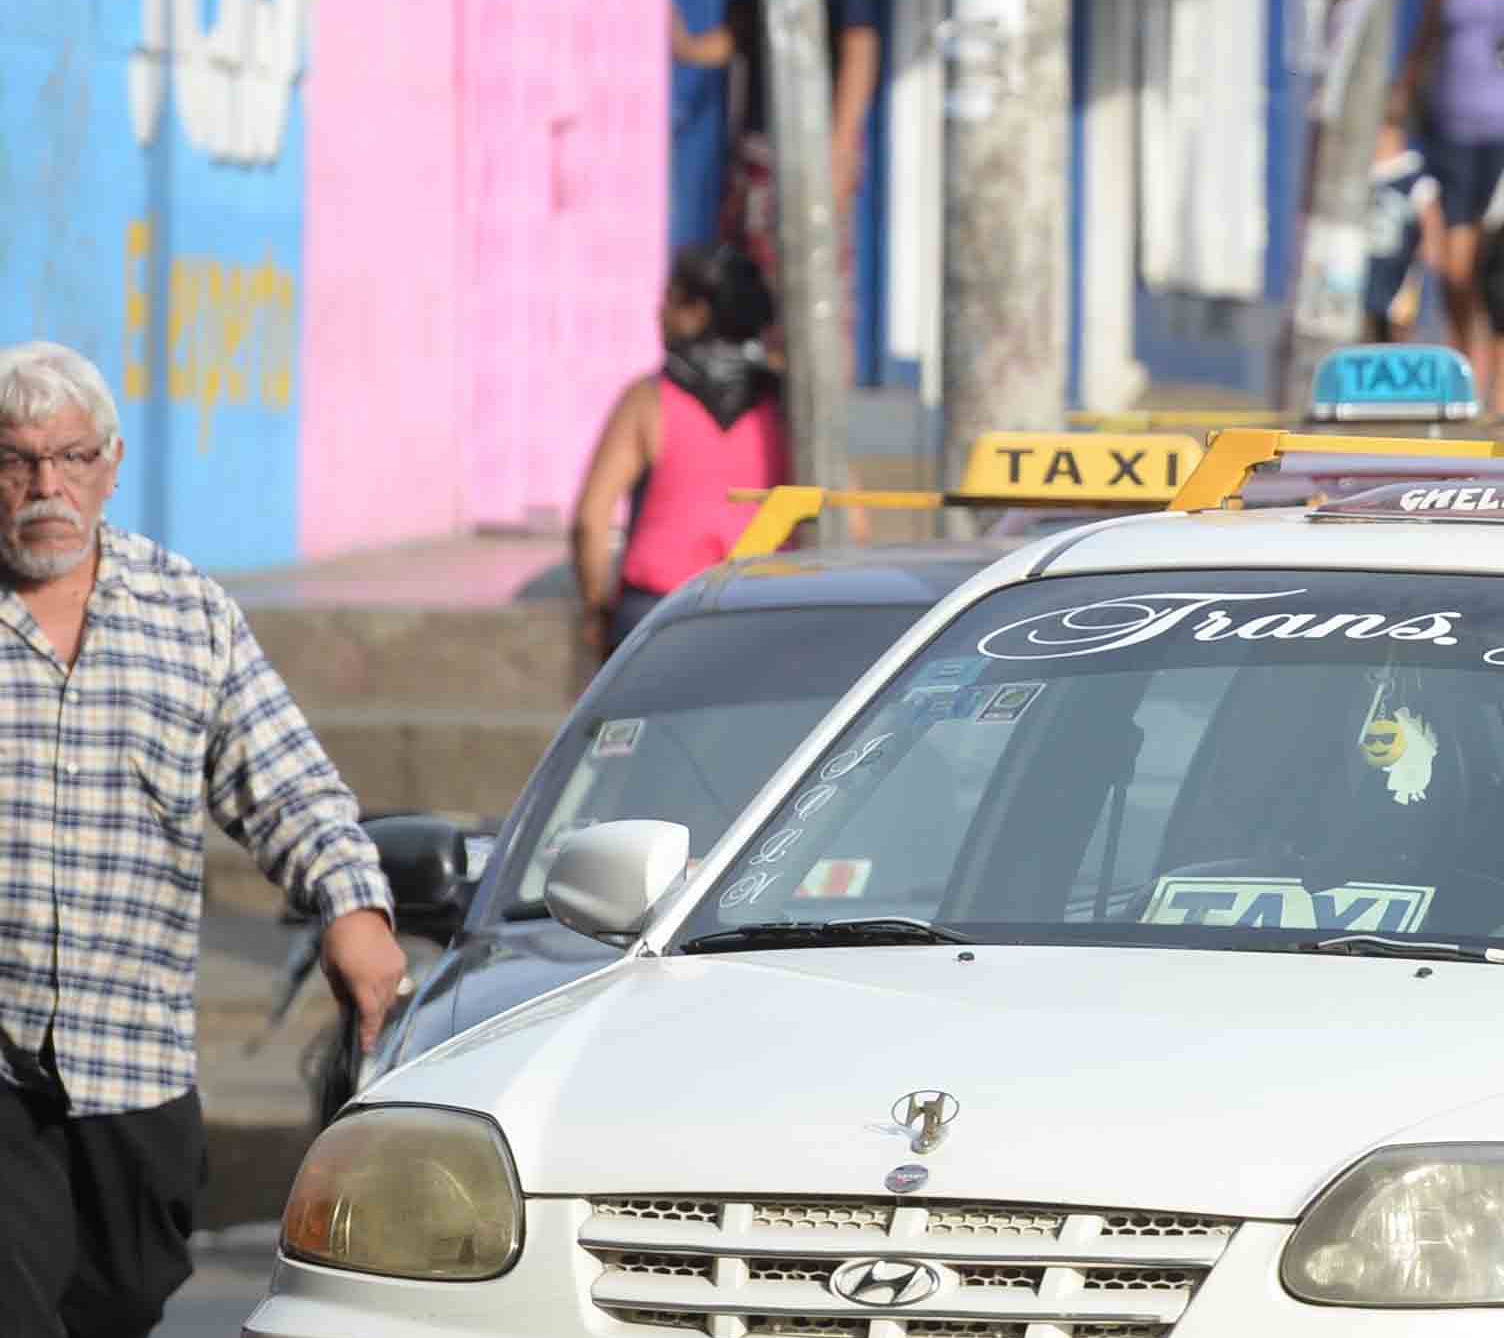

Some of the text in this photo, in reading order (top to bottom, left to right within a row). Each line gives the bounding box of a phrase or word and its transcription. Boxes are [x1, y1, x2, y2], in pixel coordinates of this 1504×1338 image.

[1348, 354, 1439, 393] TAXI
[996, 447, 1180, 487] TAXI
[976, 587, 1462, 663] Trans.
[1164, 889, 1412, 934] TAXI
